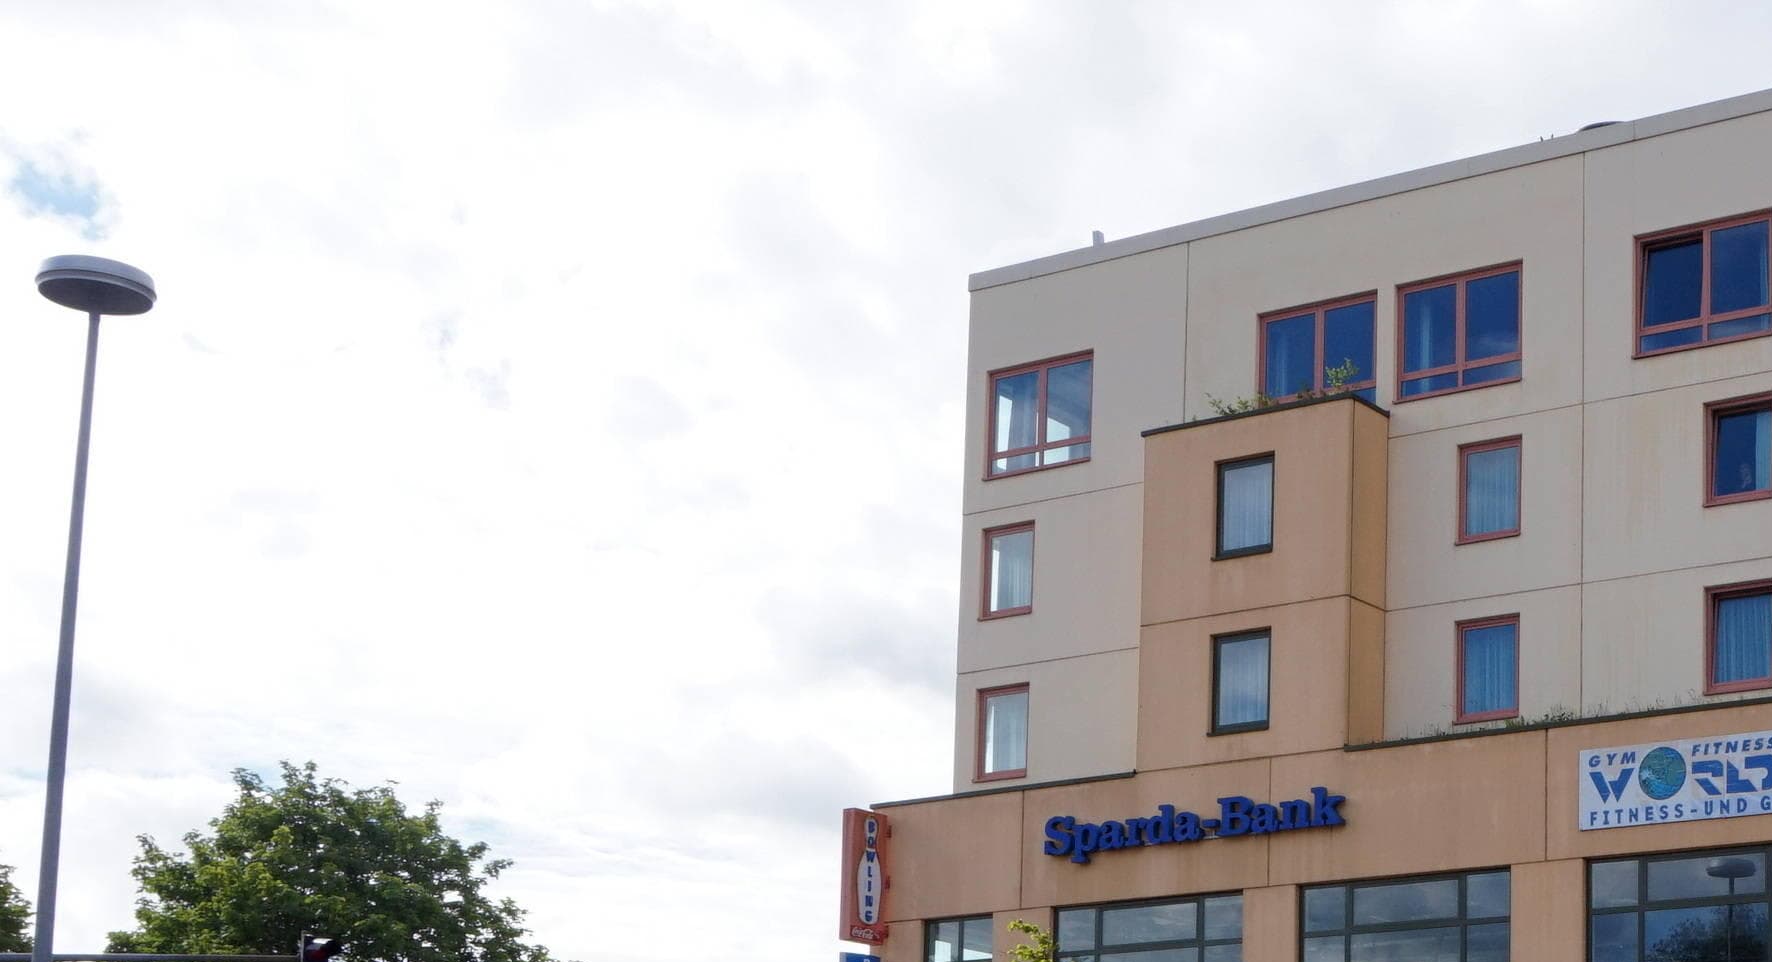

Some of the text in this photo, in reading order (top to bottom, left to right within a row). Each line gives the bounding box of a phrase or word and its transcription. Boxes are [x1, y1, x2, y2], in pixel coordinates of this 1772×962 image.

[1588, 751, 1636, 768] GYM
[1044, 787, 1346, 864] Sparda-Bank
[864, 820, 876, 923] BOWLING
